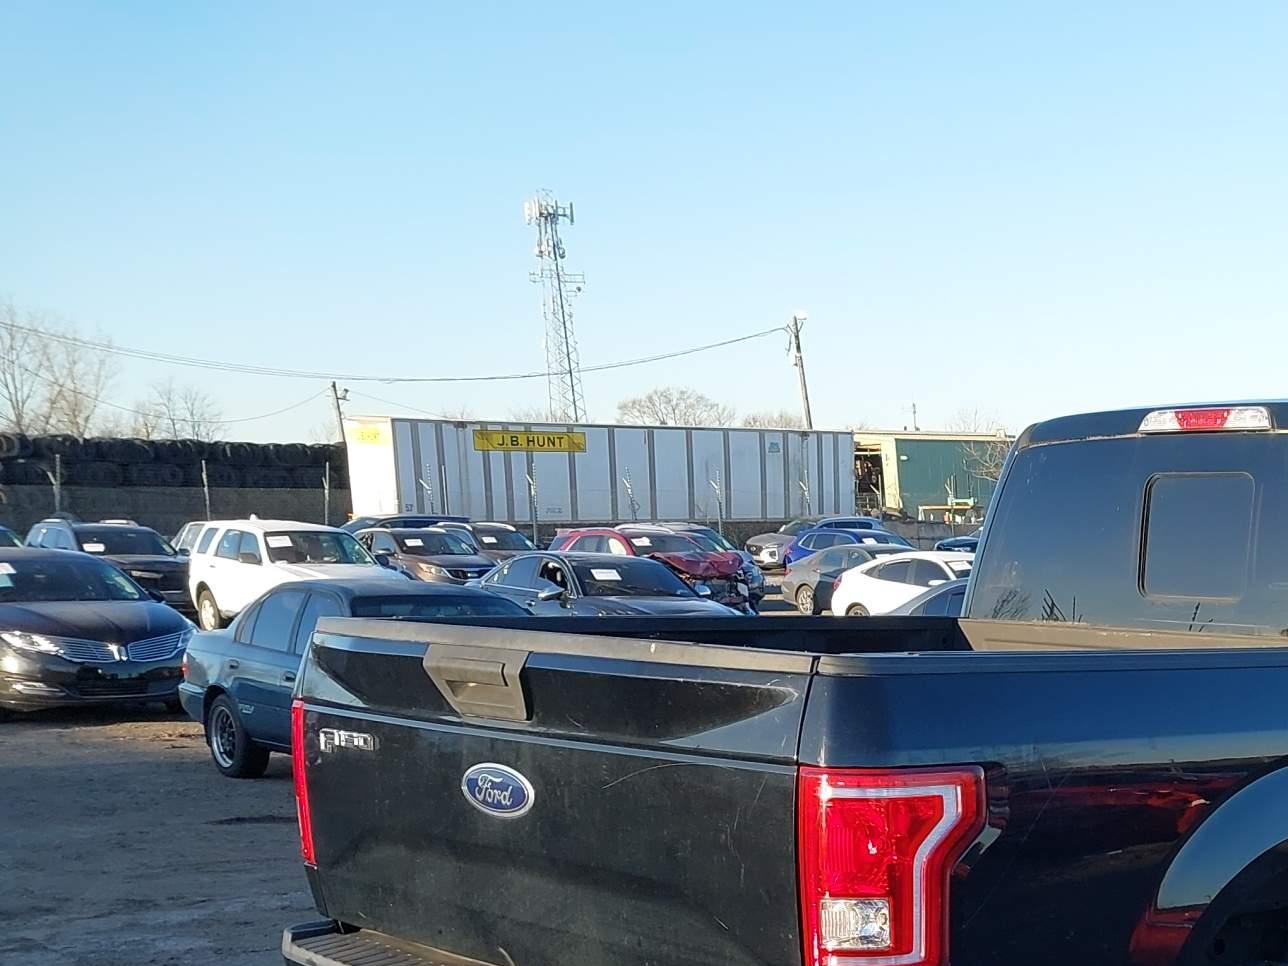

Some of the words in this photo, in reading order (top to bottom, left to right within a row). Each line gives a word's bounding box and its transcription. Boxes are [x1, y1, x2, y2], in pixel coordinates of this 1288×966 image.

[497, 435, 523, 447] J.B.
[526, 435, 565, 448] HUNT
[474, 773, 513, 806] Ford
